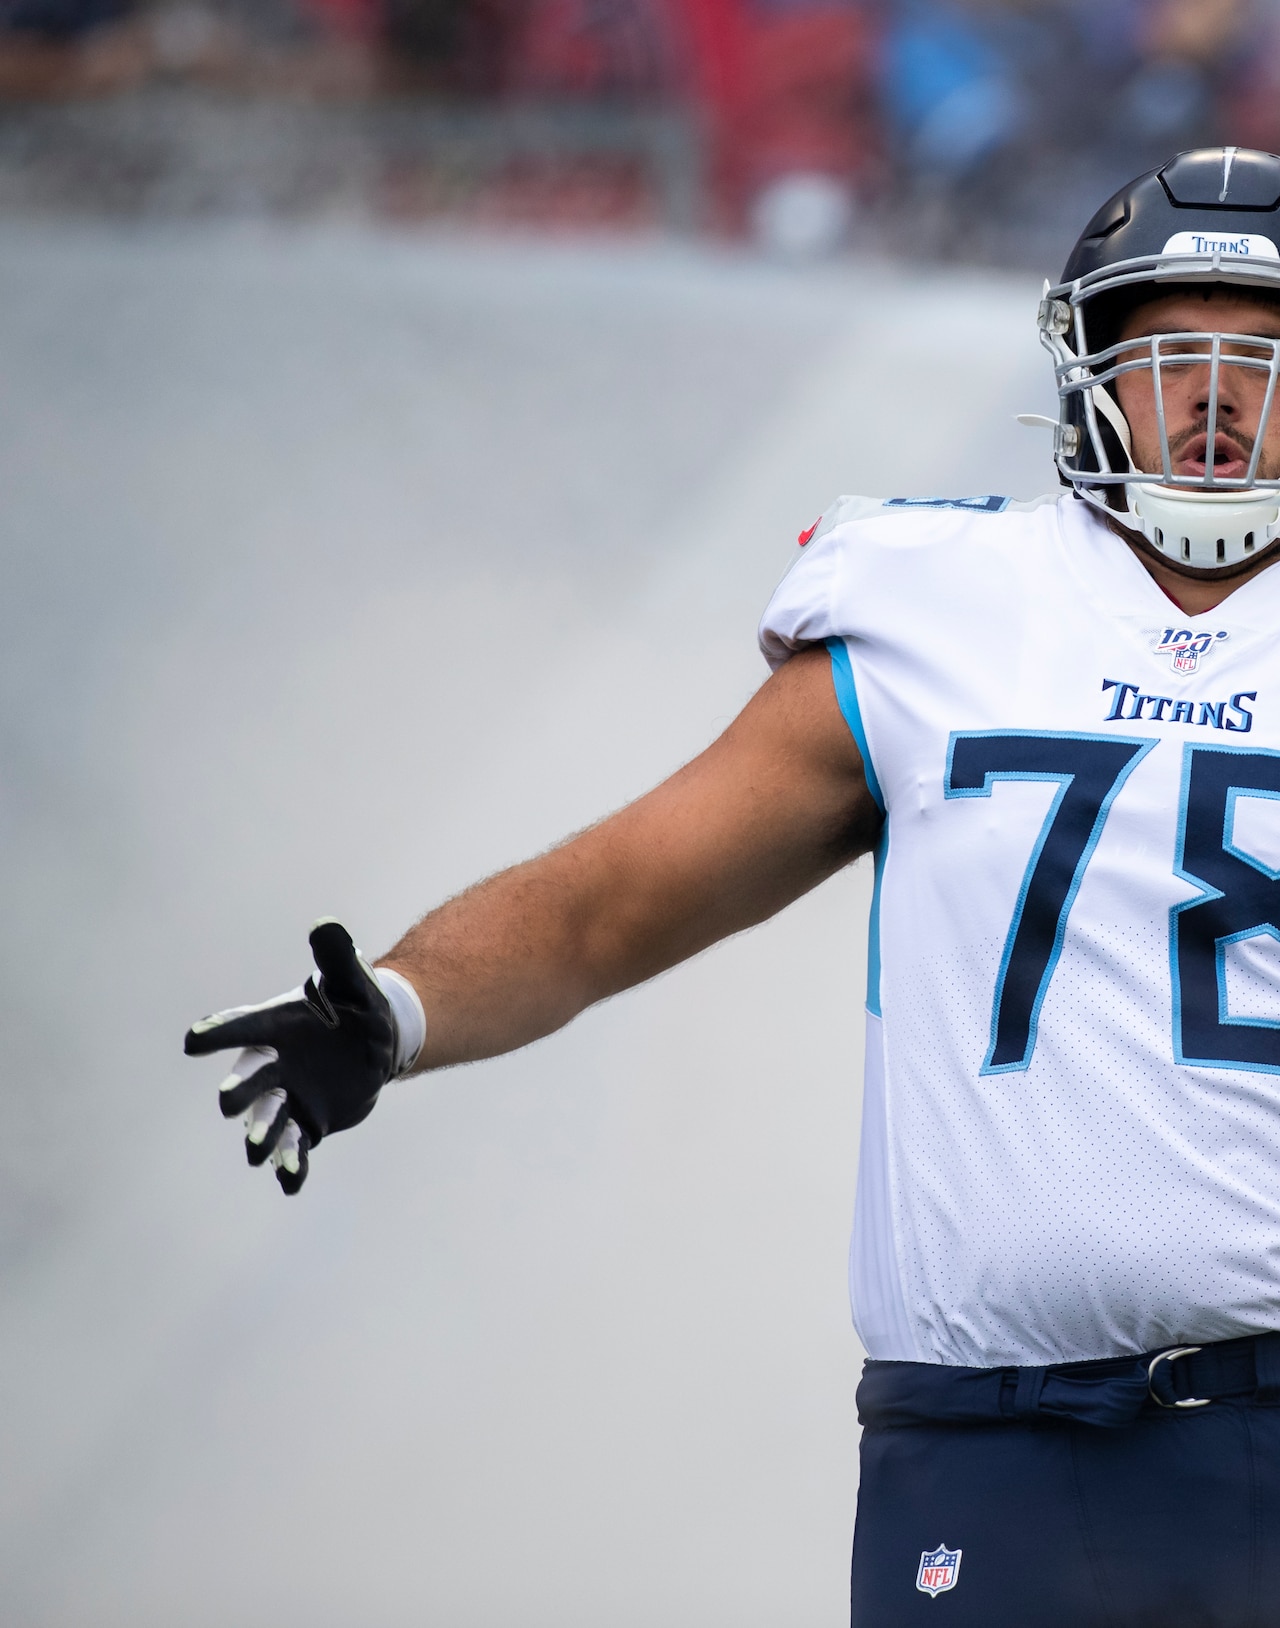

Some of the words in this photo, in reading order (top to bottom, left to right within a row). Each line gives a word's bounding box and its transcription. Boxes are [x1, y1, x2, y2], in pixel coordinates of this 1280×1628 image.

[1192, 236, 1250, 254] TITANS
[1176, 658, 1194, 669] NFL
[1102, 678, 1257, 732] TITANS
[922, 1568, 951, 1587] NFL
